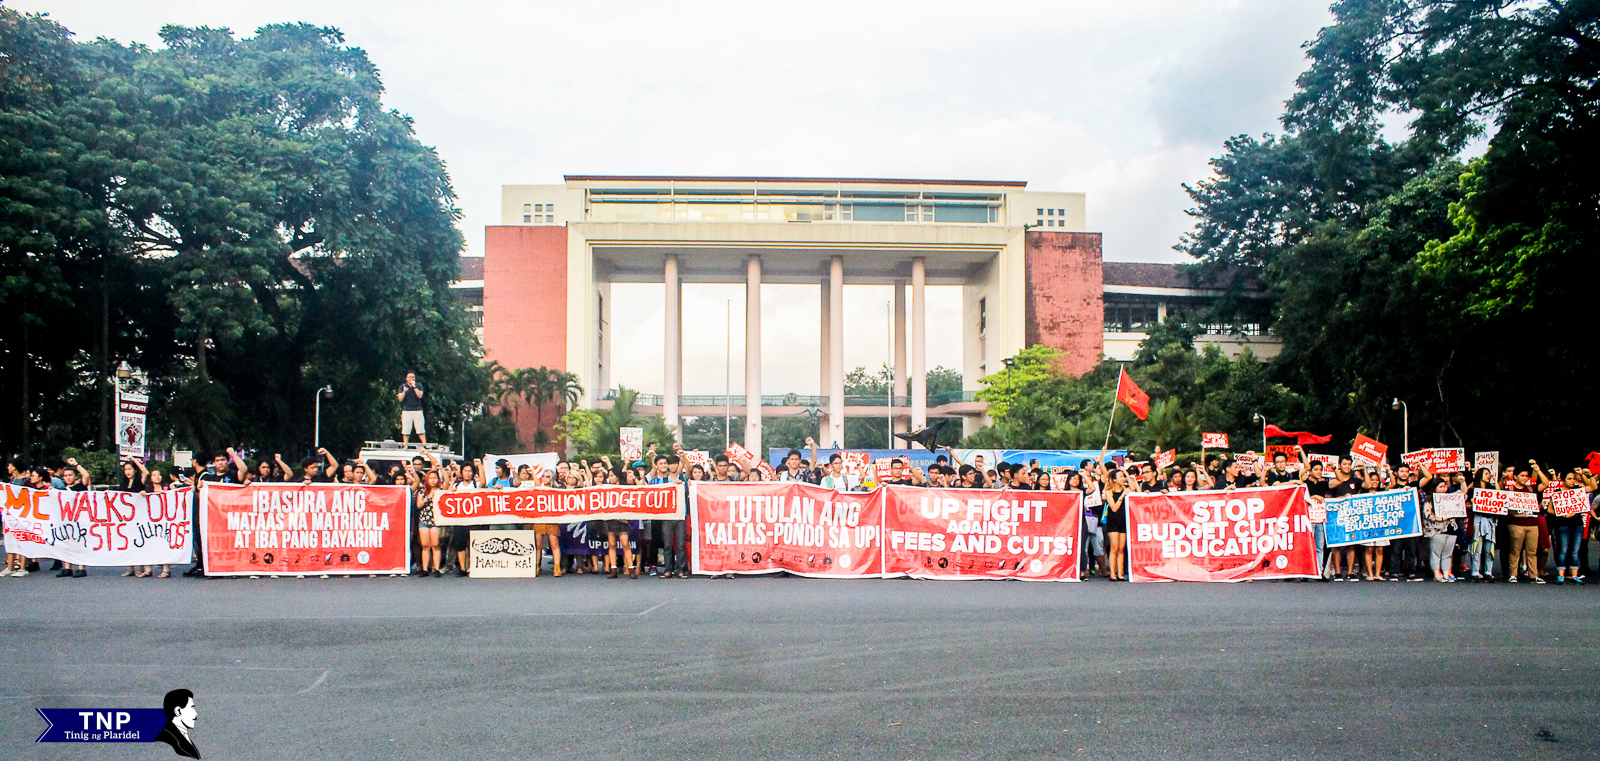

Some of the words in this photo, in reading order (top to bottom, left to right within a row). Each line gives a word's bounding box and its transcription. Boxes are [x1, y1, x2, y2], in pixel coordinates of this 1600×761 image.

[0, 484, 50, 520] MC
[58, 490, 136, 523] WALKS
[146, 487, 193, 522] OUT
[253, 490, 328, 513] IBASURA
[331, 490, 366, 513] ANG
[445, 496, 483, 514] STOP
[487, 495, 511, 512] THE
[514, 496, 535, 511] 2.2
[537, 493, 585, 512] BILLION
[589, 490, 645, 511] BUDGET
[645, 490, 677, 509] CUT!
[1353, 498, 1373, 508] RISE
[1374, 493, 1412, 506] AGAINST
[1473, 497, 1504, 507] tuition
[1480, 490, 1493, 498] no
[1496, 491, 1507, 500] to
[1552, 490, 1575, 500] STOP
[726, 496, 815, 525] TUTULAN
[820, 501, 862, 528] ANG
[920, 497, 960, 520] UP
[966, 499, 1048, 523] FIGHT
[1192, 498, 1265, 523] STOP
[1337, 505, 1374, 518] BUDGET
[1375, 502, 1403, 513] CUTS!
[1363, 513, 1385, 523] RISE
[1386, 510, 1405, 519] FOR
[1555, 504, 1581, 516] BUDGET
[227, 512, 285, 531] MATAAS
[288, 512, 308, 530] NA
[311, 512, 390, 530] MATRIKULA
[946, 520, 1020, 536] AGAINST
[1137, 521, 1229, 542] BUDGET
[1233, 517, 1290, 538] CUTS
[1293, 514, 1313, 534] IN
[1345, 518, 1399, 533] EDUCATION!
[45, 522, 88, 547] junk
[90, 522, 129, 551] STS
[134, 522, 171, 548] junk
[234, 531, 251, 549] AT
[255, 531, 279, 548] IBA
[281, 531, 319, 548] PANG
[321, 531, 383, 548] BAYARIN!
[704, 522, 825, 548] KALTAS-PONDO
[828, 526, 850, 548] SA
[854, 525, 881, 549] UP!
[891, 531, 947, 552] FEES
[949, 535, 1001, 554] AND
[1007, 536, 1074, 556] CUTS!
[588, 540, 602, 550] UP
[1162, 532, 1294, 558] EDUCATION!
[475, 556, 509, 569] MAMILI
[514, 556, 532, 569] KA!
